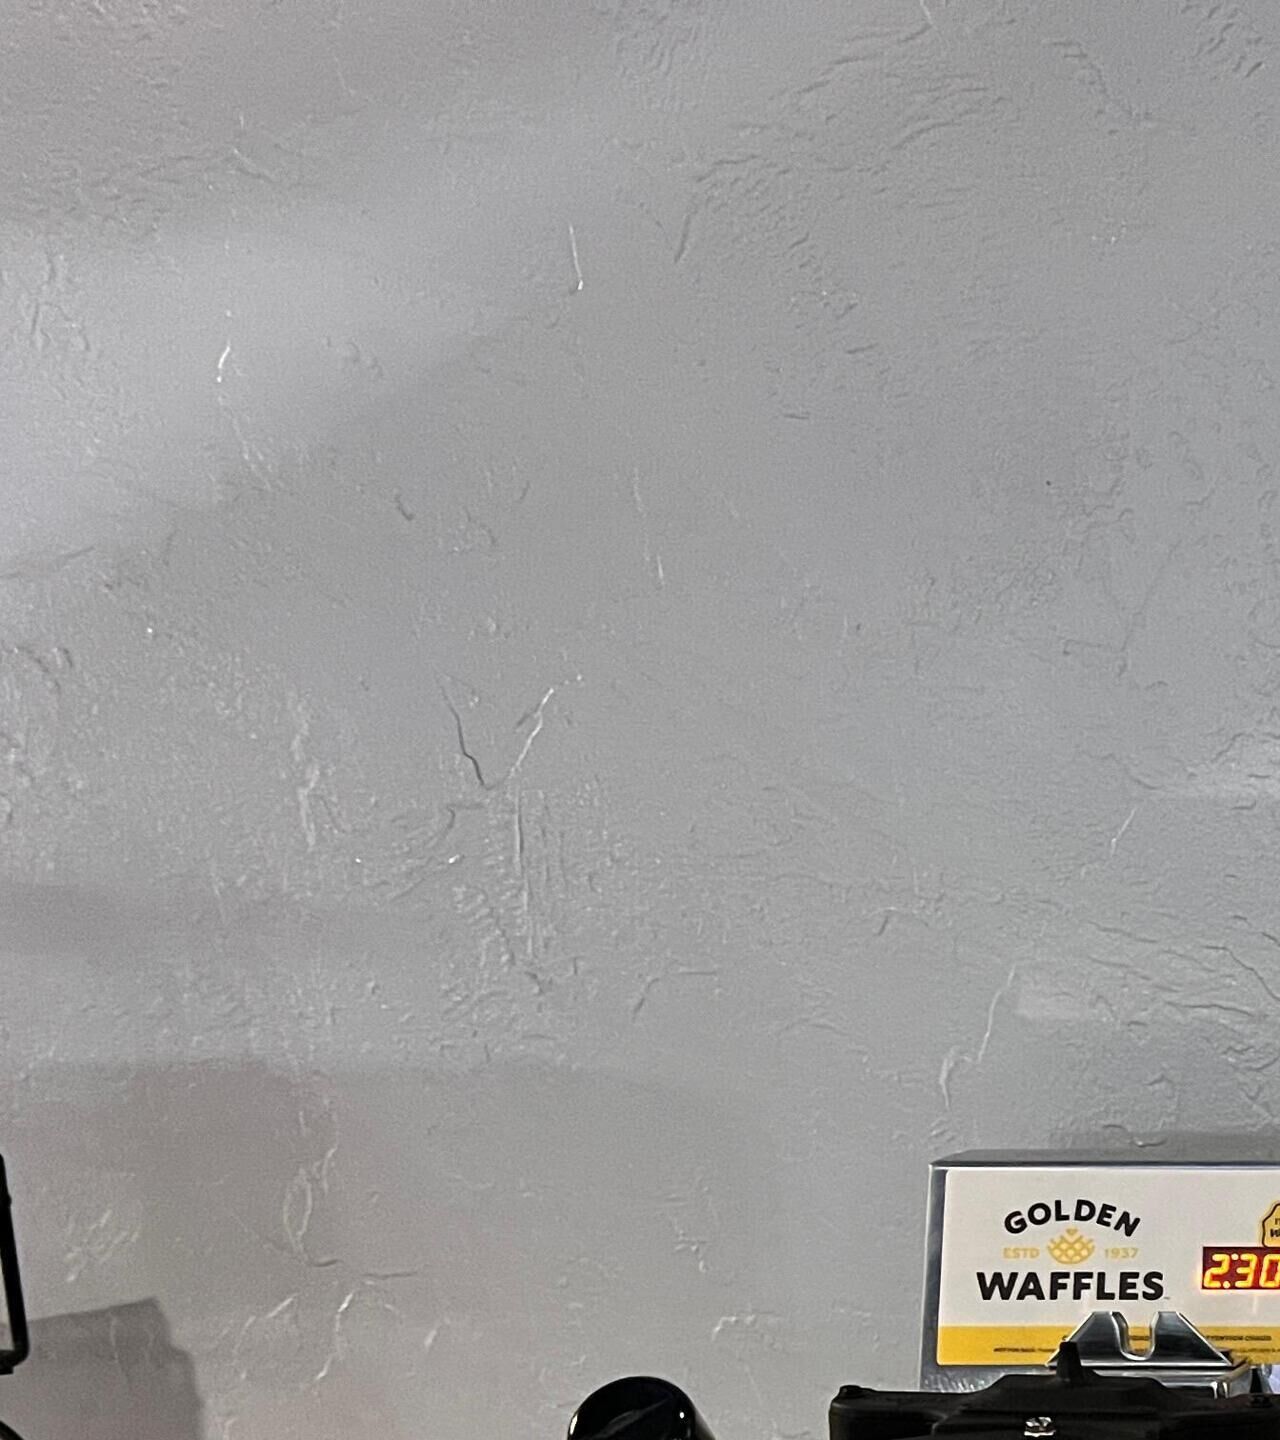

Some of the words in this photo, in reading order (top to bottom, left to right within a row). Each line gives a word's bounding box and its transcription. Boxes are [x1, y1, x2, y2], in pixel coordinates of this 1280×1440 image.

[1004, 1199, 1141, 1237] GOLDEN
[1003, 1247, 1041, 1259] ESTD
[976, 1271, 1164, 1301] WAFFLES
